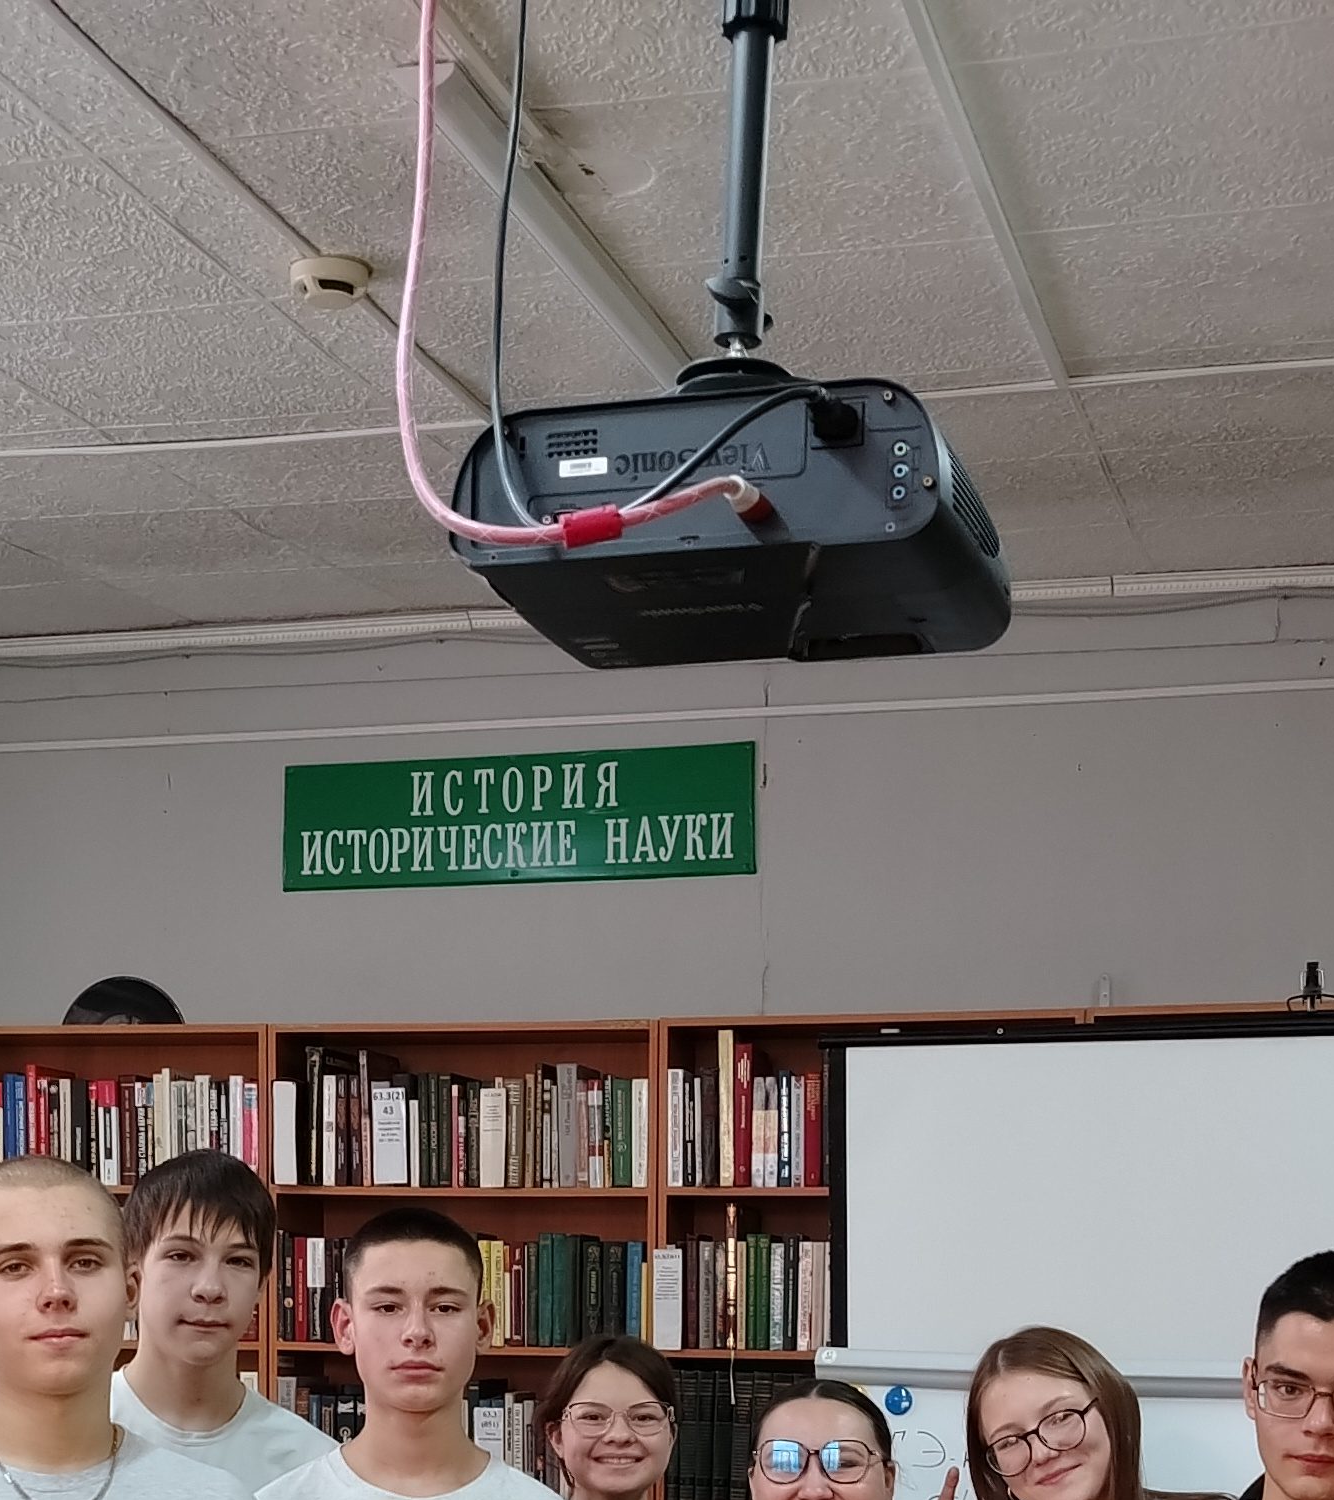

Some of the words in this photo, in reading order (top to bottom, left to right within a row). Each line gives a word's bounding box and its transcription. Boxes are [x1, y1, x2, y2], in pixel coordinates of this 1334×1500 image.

[410, 761, 619, 817] ИСТОРИЯ
[300, 819, 577, 876] ИСТОРИЧЕСКИЕ
[604, 812, 734, 864] НАУКИ
[373, 1091, 405, 1101] 63.3(2)
[383, 1106, 394, 1115] 43
